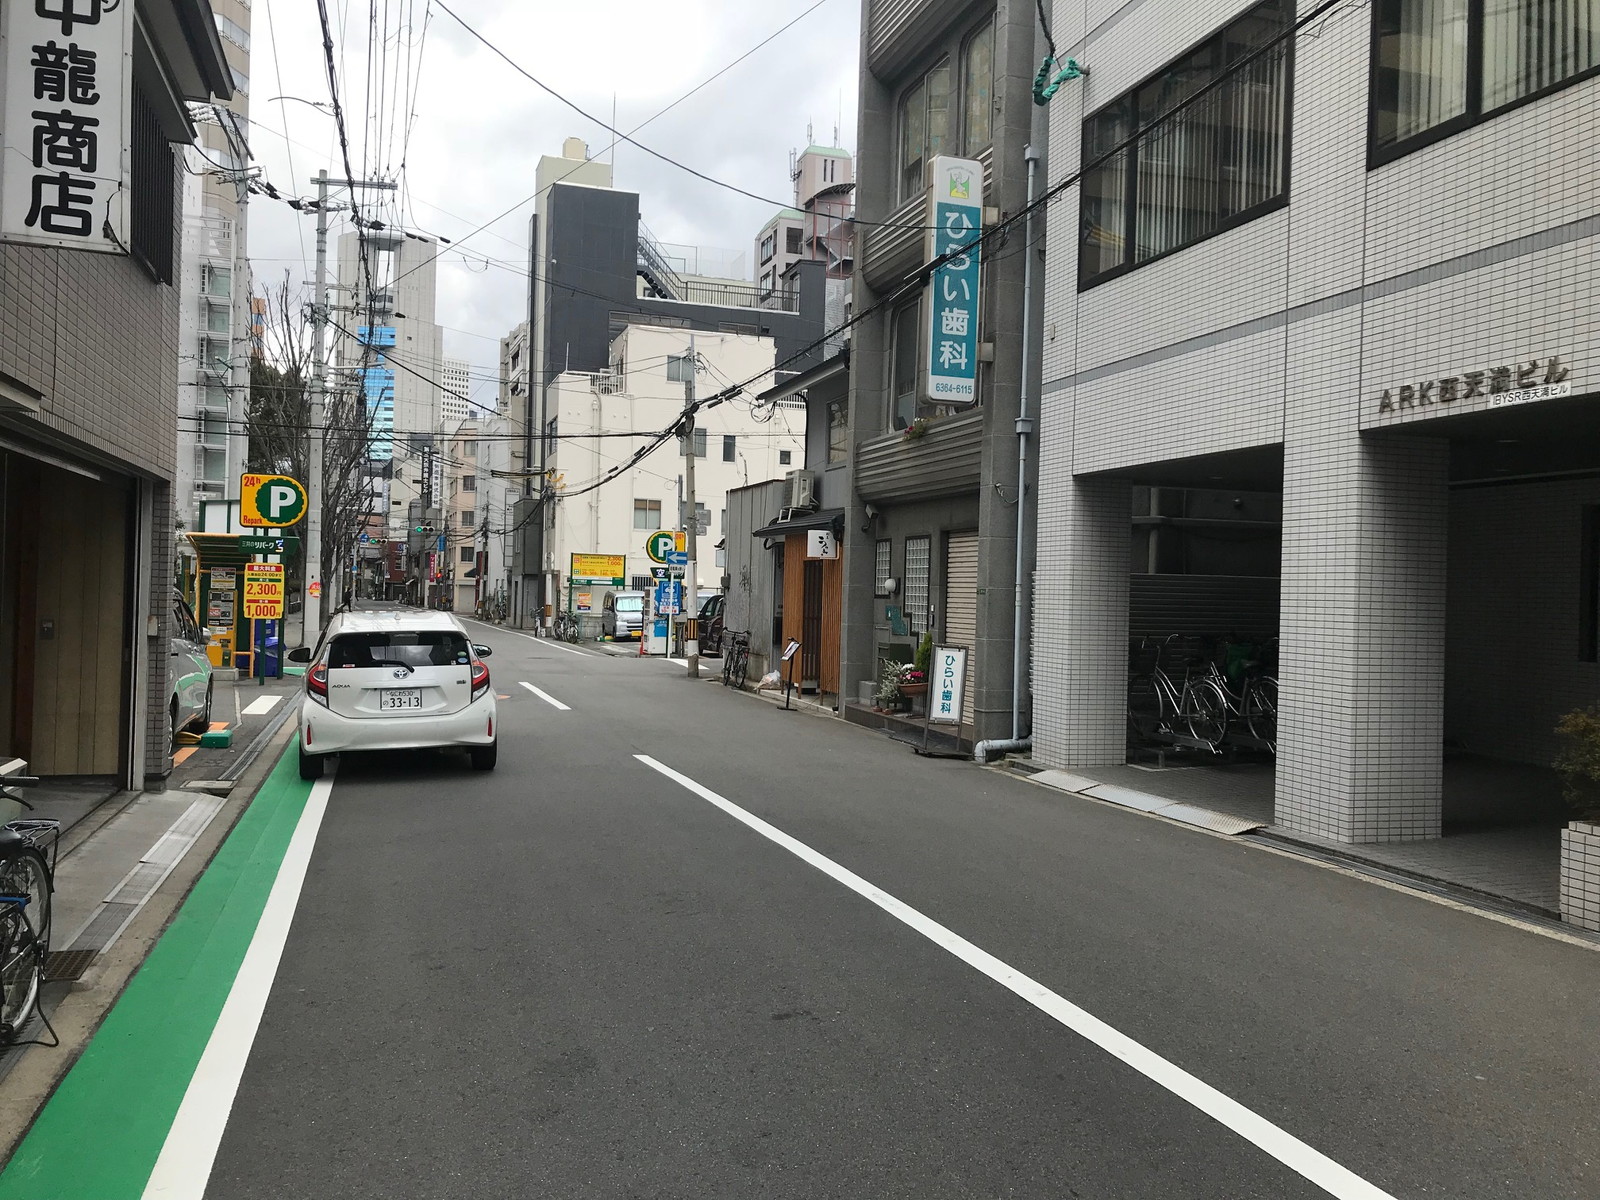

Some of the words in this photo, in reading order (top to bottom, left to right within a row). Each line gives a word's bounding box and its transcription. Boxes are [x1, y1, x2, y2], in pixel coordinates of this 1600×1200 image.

[940, 211, 974, 370] ひらい歯科
[935, 382, 973, 395] 6364-6115
[244, 475, 261, 487] 24h
[270, 485, 297, 518] P
[243, 515, 263, 525] Repark
[242, 540, 275, 549] 三井のリパーク
[940, 655, 956, 714] ひらい歯科
